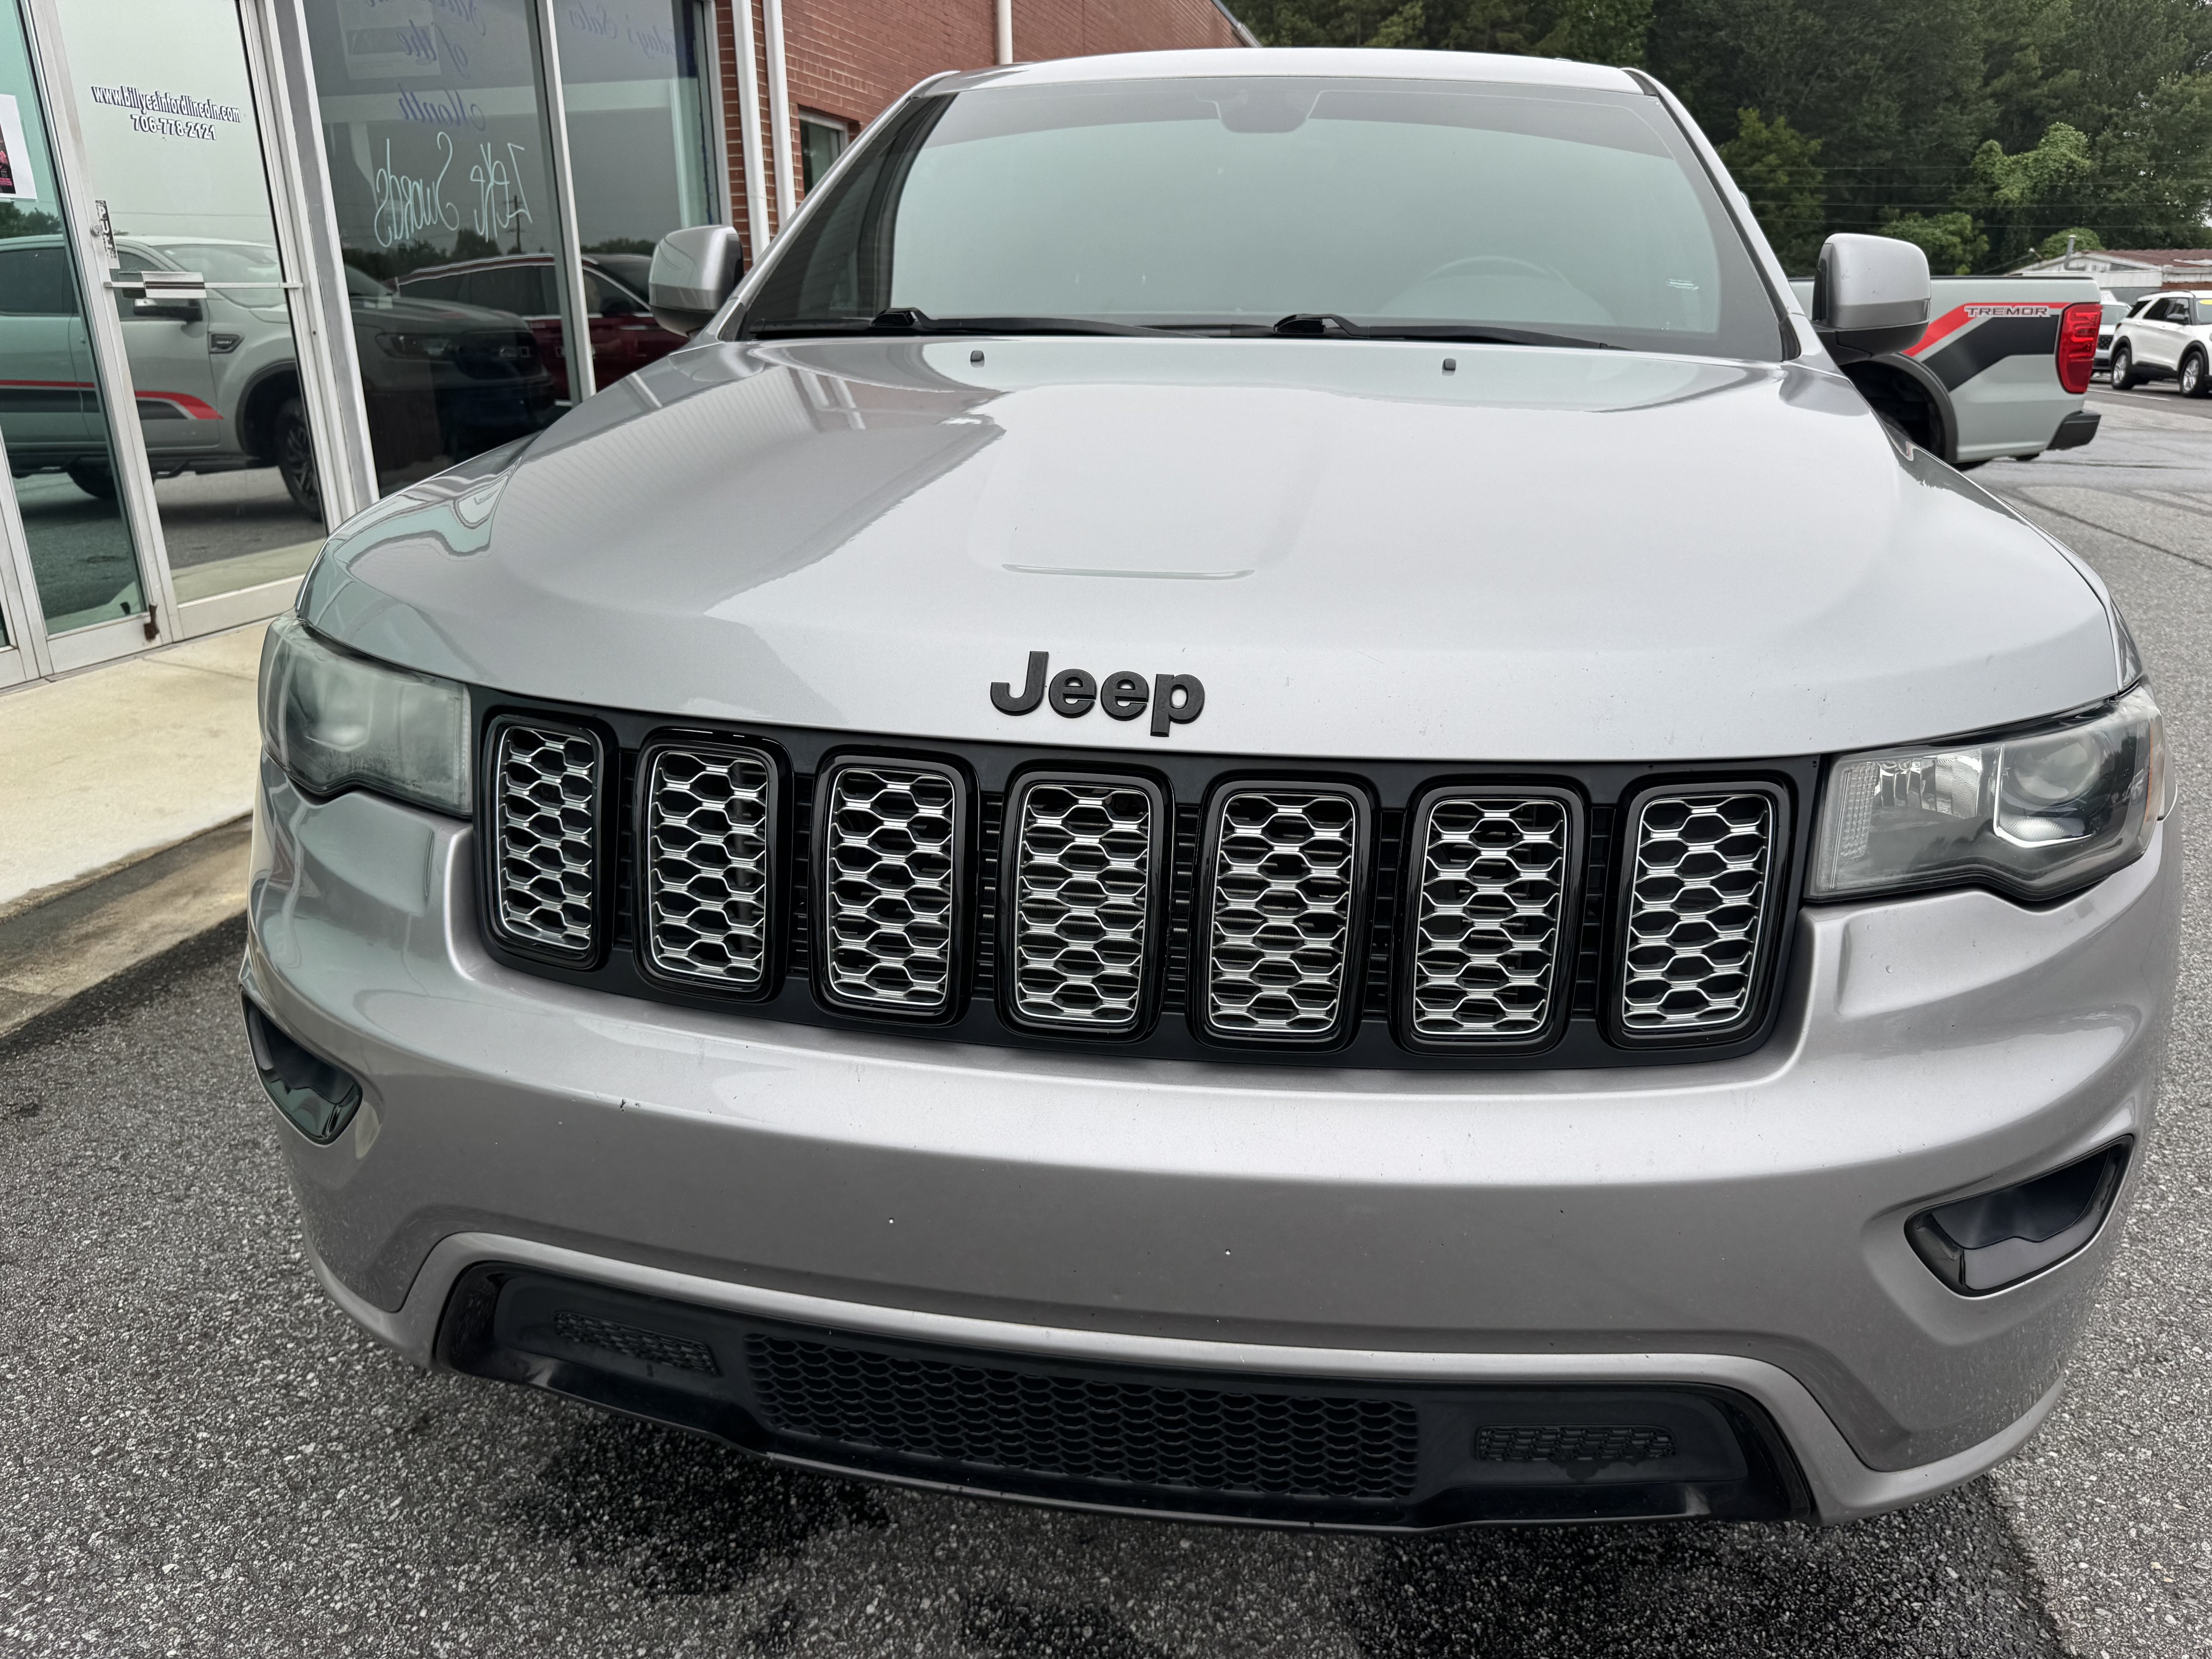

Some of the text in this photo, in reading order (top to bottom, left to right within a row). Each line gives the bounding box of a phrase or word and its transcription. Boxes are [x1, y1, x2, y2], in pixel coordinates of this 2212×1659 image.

[91, 86, 242, 123] www.billycainfordlincoln.com
[130, 114, 216, 141] 706-778-2121
[1965, 306, 2050, 317] TREMOR
[990, 651, 1205, 737] Jeep
